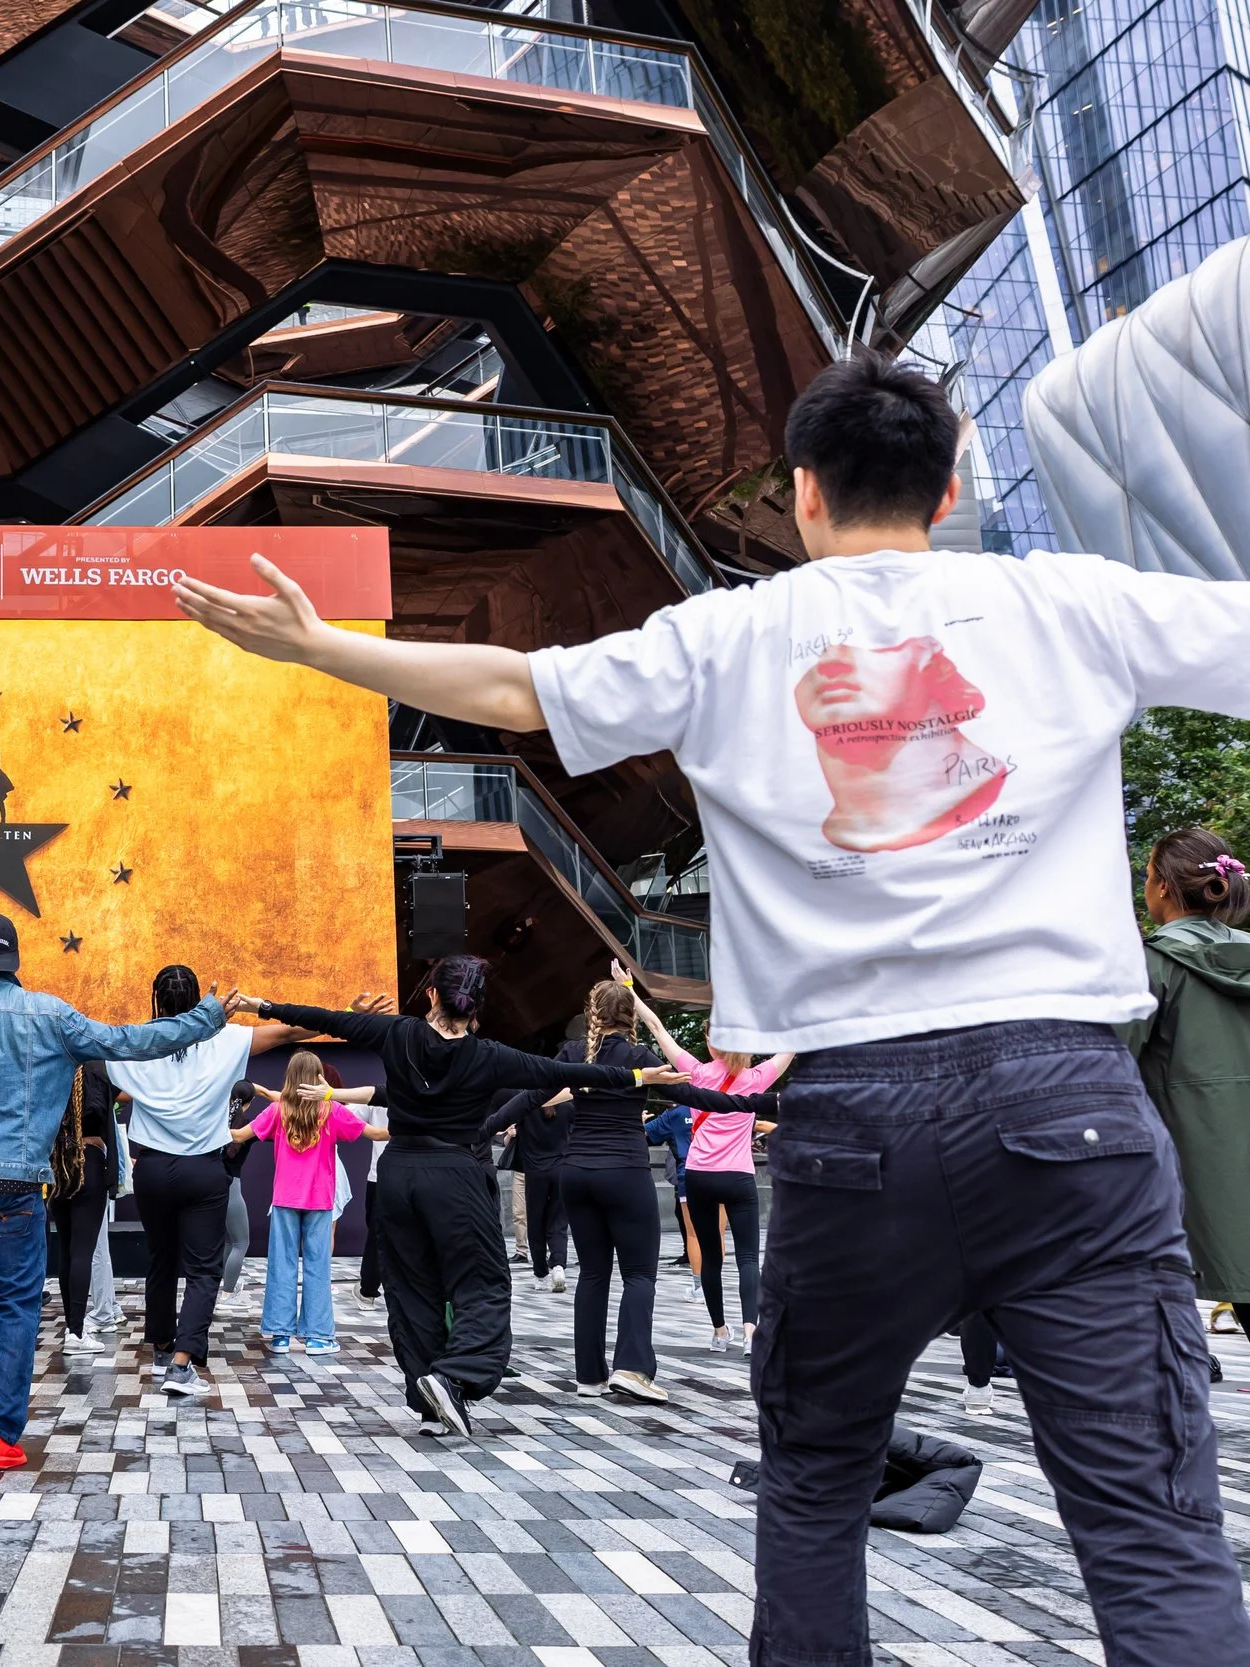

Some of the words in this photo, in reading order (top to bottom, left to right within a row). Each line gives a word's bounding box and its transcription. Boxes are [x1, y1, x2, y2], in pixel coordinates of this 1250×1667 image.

[75, 556, 120, 564] PRESENTED
[121, 556, 131, 564] BY
[20, 568, 102, 586] WELLS
[108, 568, 188, 586] FARGO
[814, 719, 895, 738] SERIOUSLY
[897, 708, 982, 731] NOSTALGIC
[836, 737, 845, 745] A
[847, 733, 907, 745] retrospective
[909, 726, 959, 742] exhibition
[942, 753, 1018, 785] PARIS
